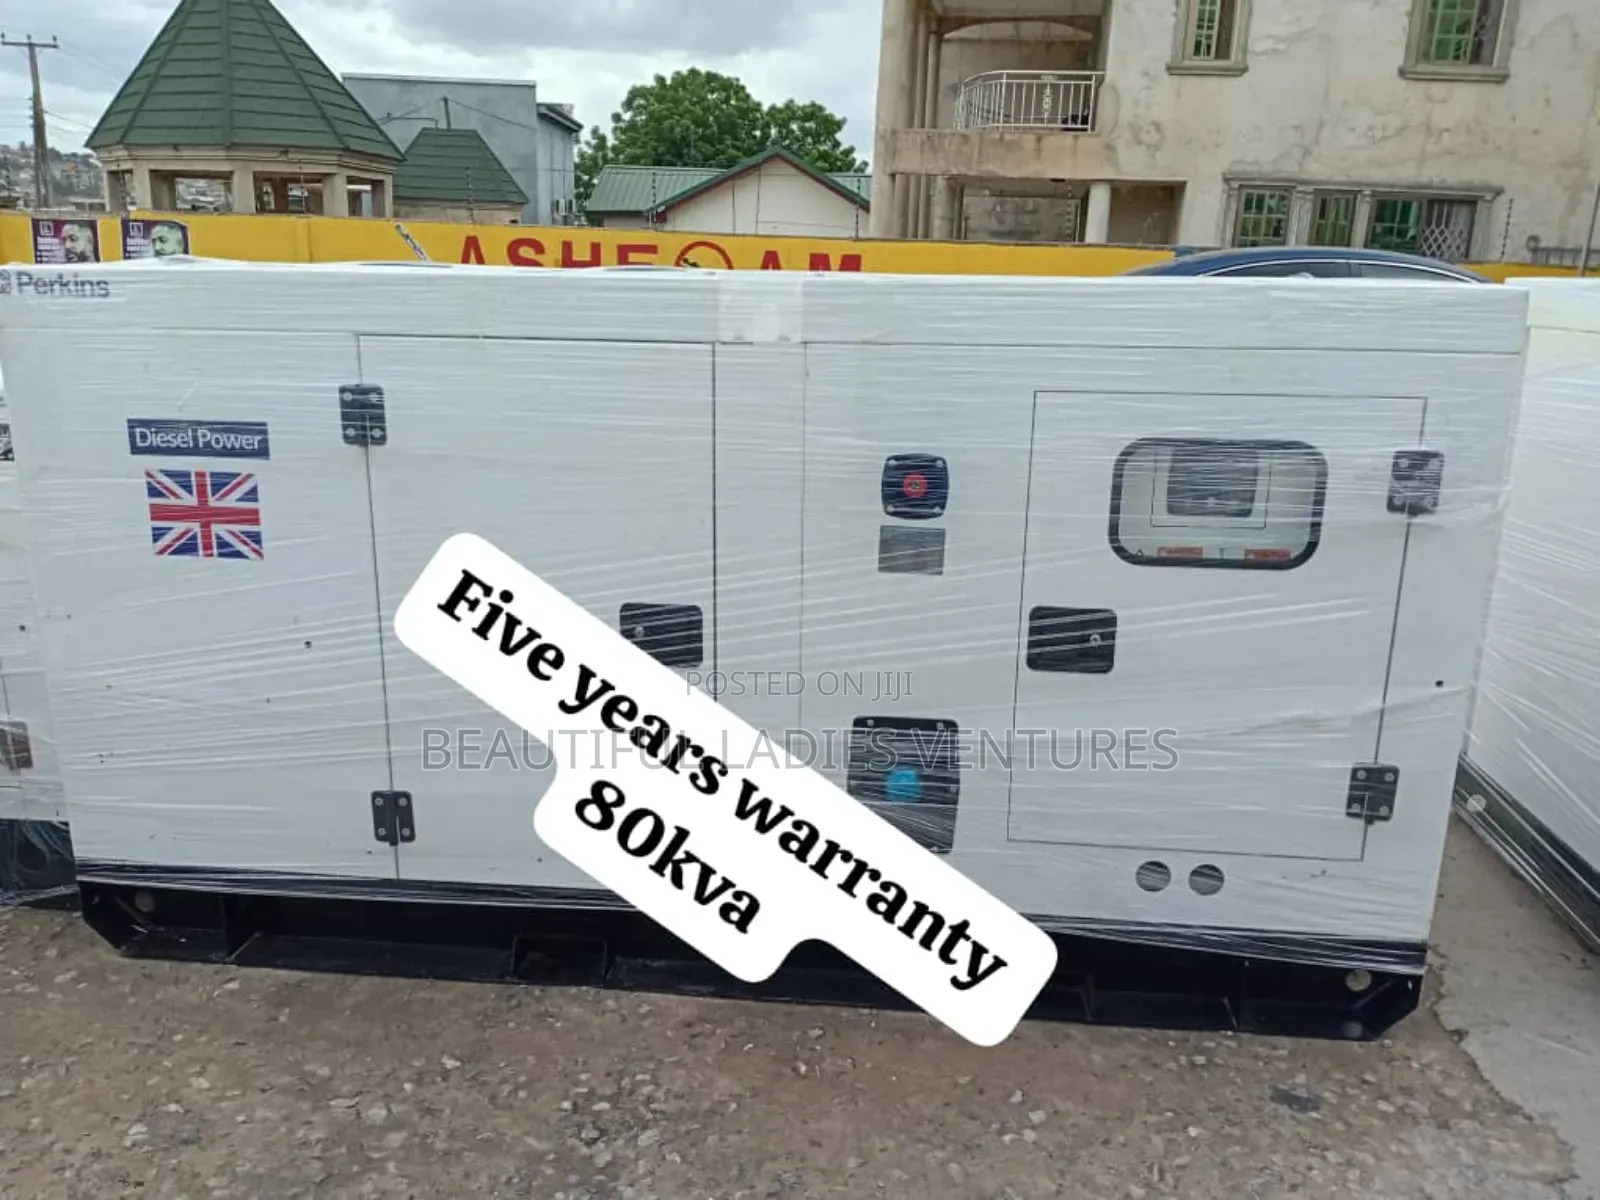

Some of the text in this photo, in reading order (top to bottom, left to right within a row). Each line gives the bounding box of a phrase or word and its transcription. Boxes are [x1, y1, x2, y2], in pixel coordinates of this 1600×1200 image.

[16, 270, 110, 298] Perkins
[135, 426, 262, 451] Diesel Power
